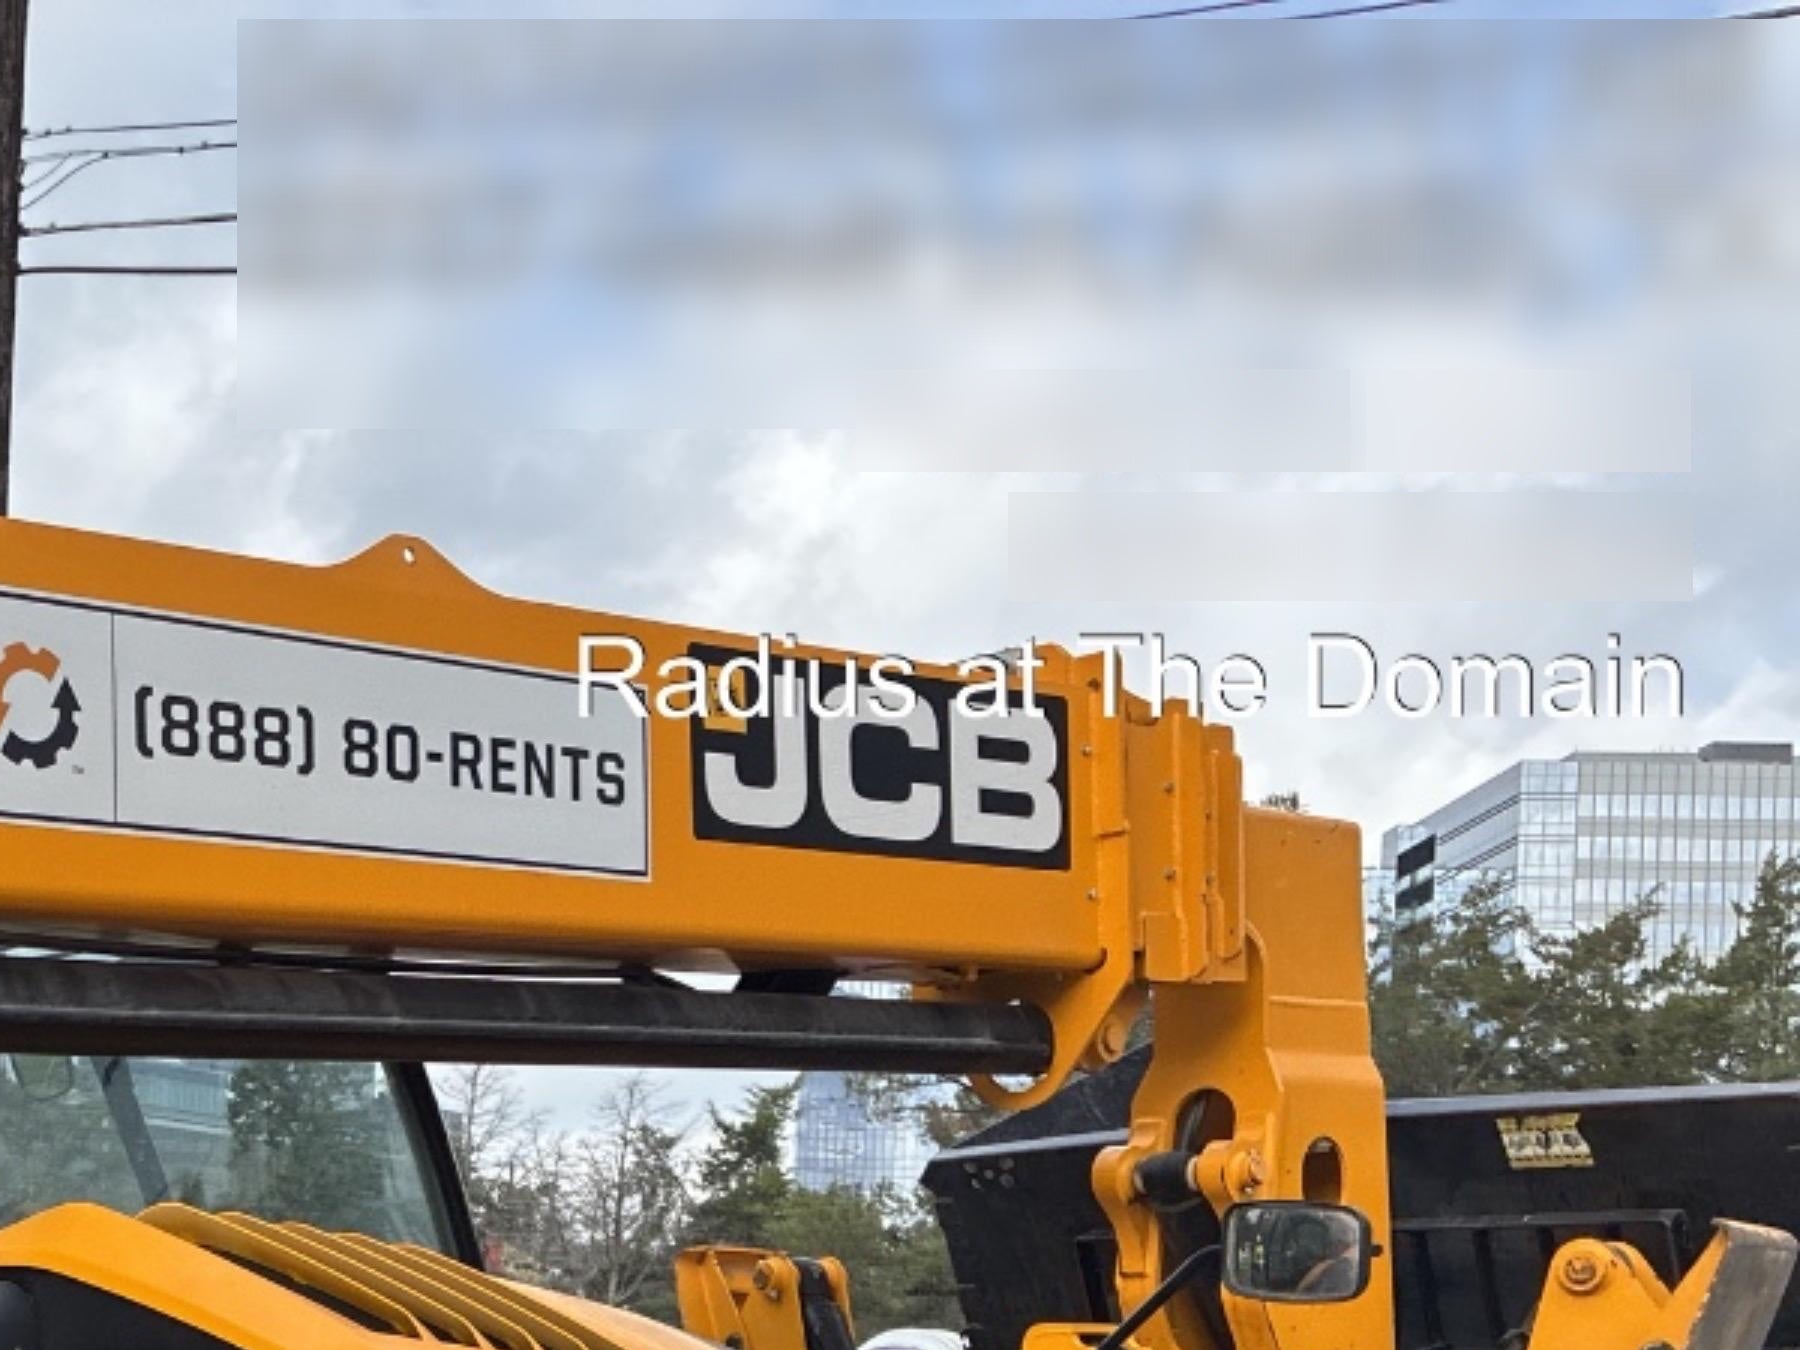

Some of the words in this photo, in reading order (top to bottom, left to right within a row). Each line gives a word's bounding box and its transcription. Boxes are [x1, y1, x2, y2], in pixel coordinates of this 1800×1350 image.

[134, 683, 315, 776] (888)
[342, 718, 625, 807] 80-RENTS
[703, 673, 1064, 853] JCB
